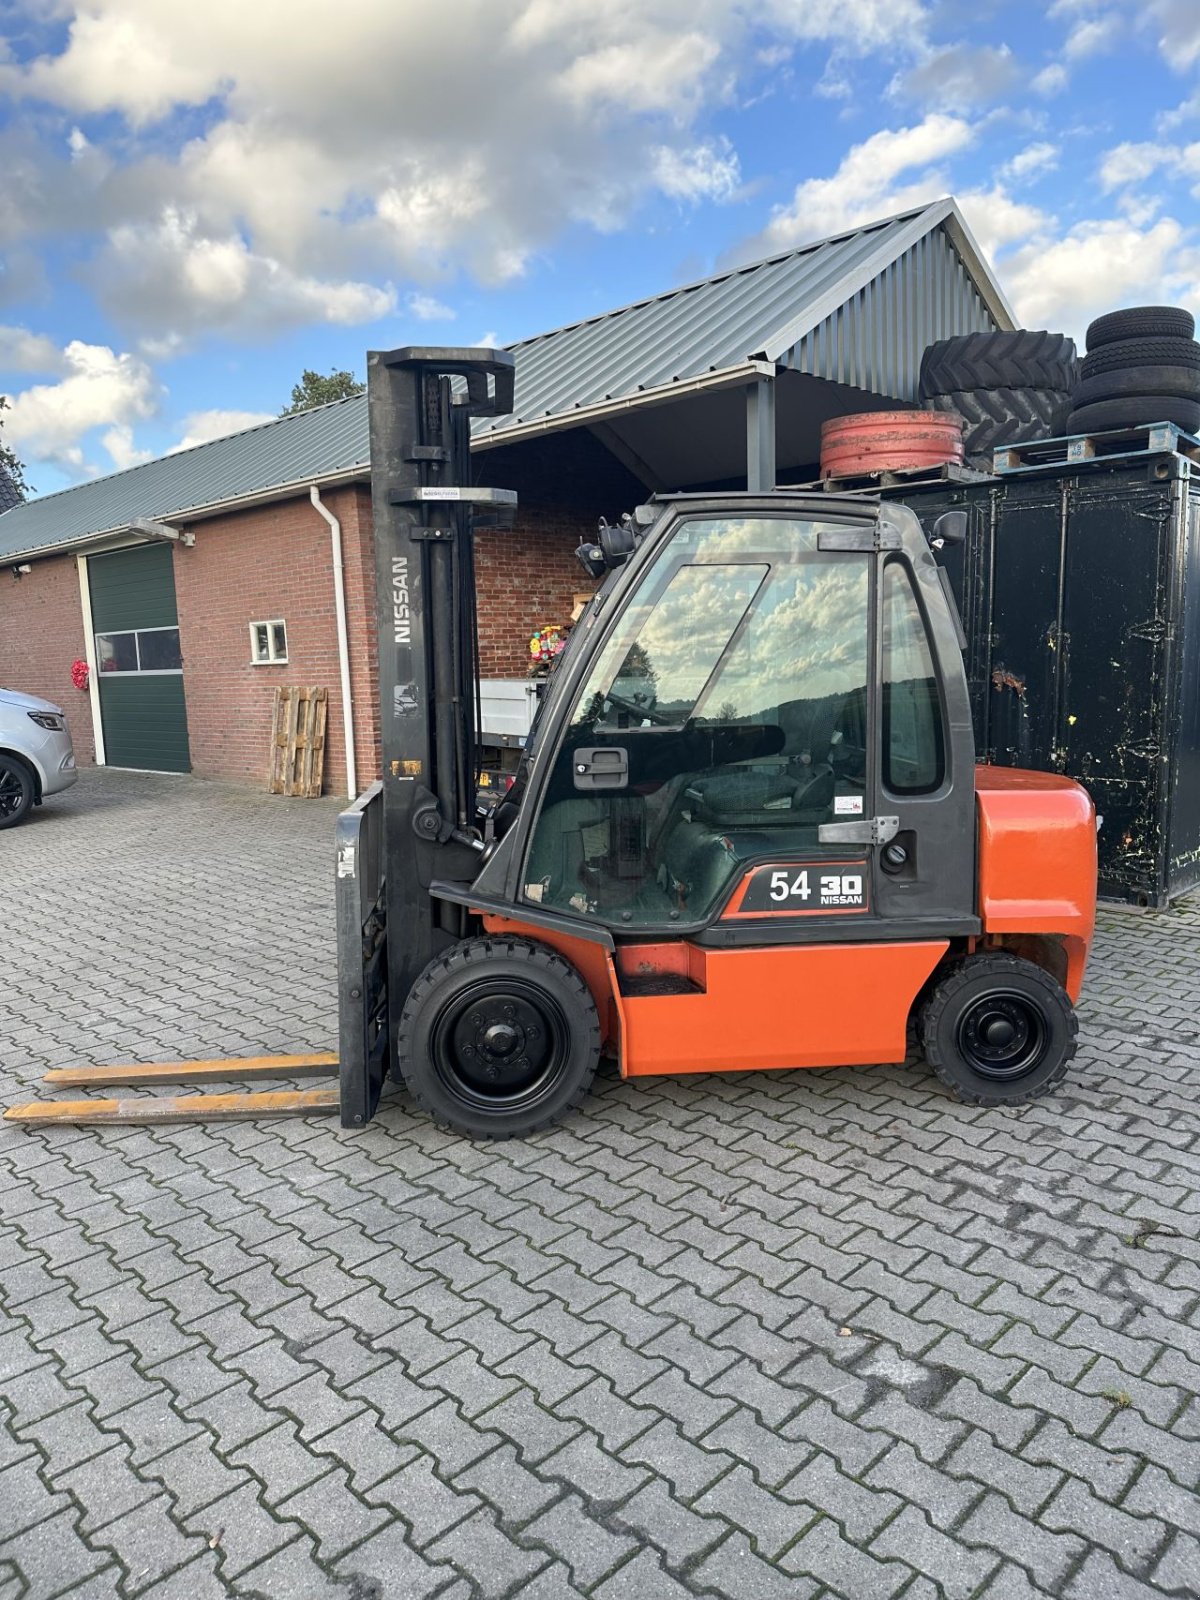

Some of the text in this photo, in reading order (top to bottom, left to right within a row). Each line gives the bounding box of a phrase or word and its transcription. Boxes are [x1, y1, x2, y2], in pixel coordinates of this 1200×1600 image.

[391, 556, 411, 643] NISSAN
[769, 870, 862, 901] 54 30
[820, 895, 862, 904] NISSAN
